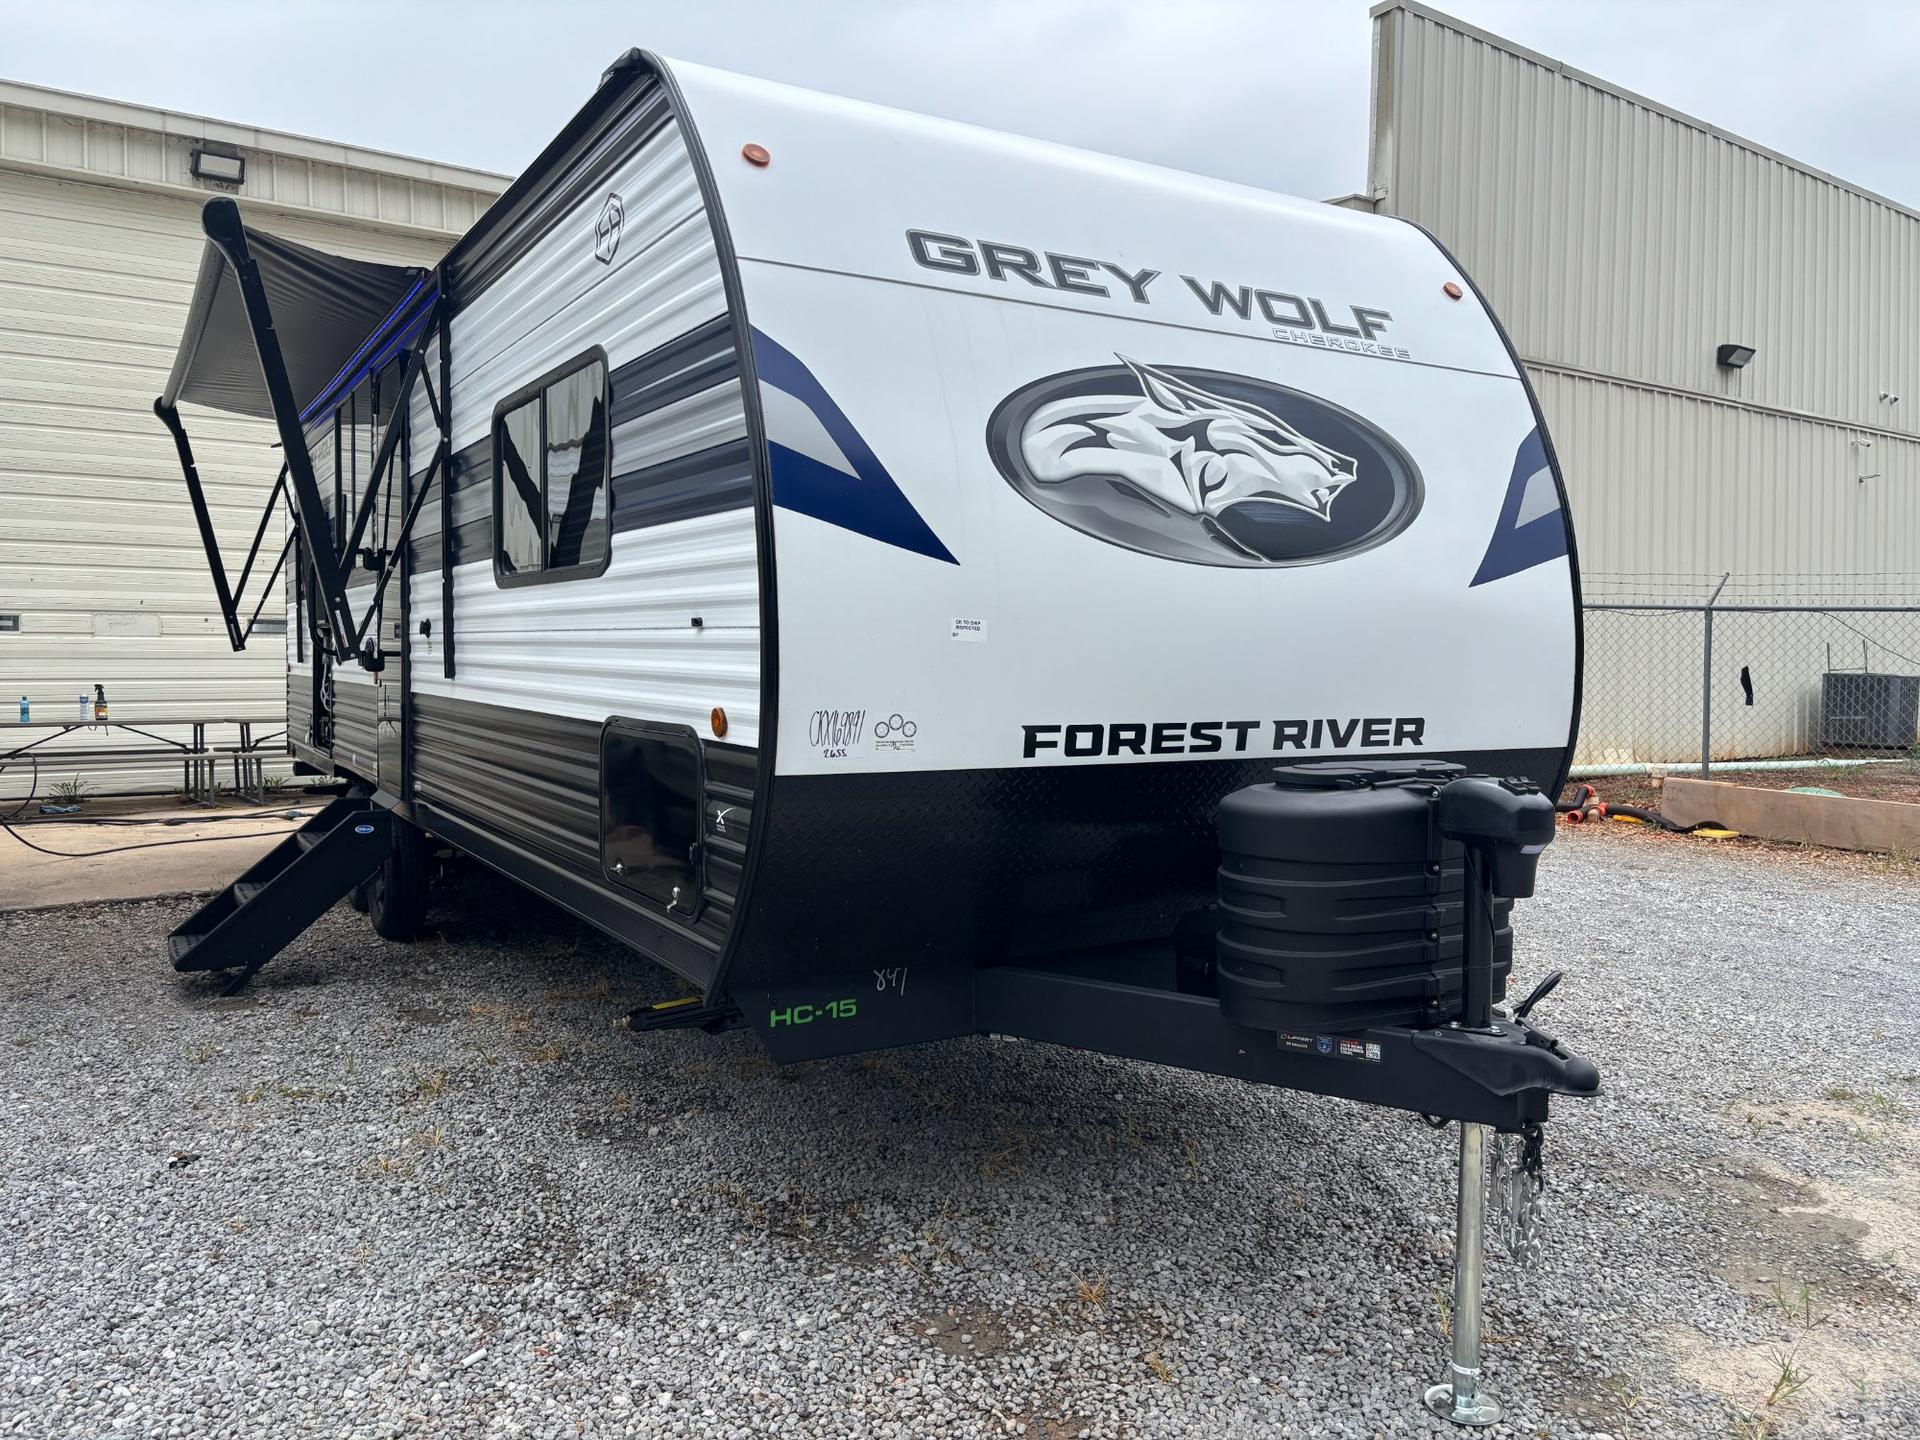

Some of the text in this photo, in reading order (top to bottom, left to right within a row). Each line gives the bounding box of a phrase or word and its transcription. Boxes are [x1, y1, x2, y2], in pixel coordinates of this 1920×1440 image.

[905, 228, 1394, 340] GREY WOLF
[1272, 328, 1411, 359] CHEROKEE
[1021, 717, 1426, 758] FOREST RIVER
[770, 999, 857, 1028] HC-15
